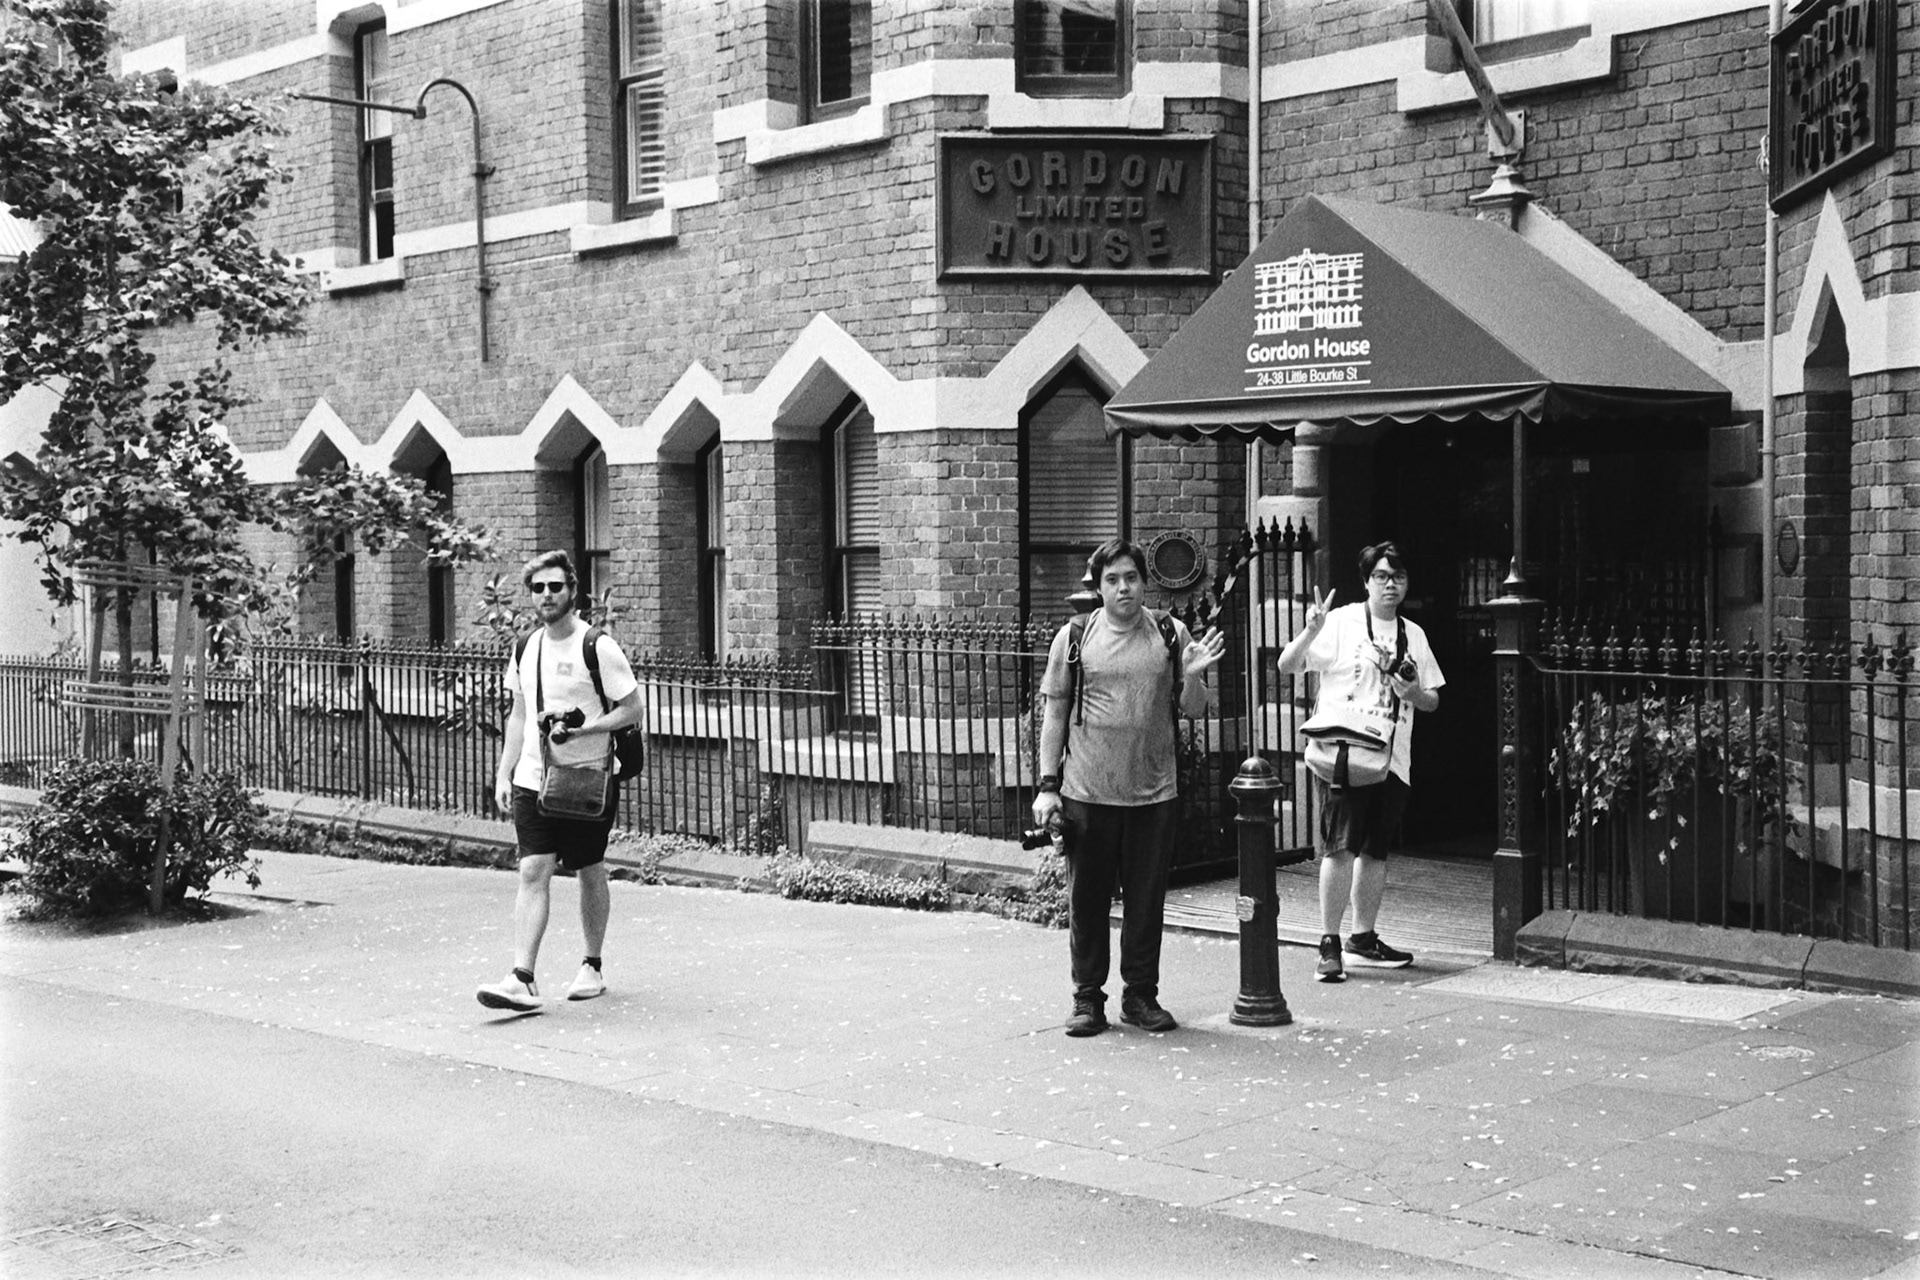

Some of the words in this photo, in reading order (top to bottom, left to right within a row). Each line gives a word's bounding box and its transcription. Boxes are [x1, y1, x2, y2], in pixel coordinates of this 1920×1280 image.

[1790, 79, 1869, 174] HOUSE
[969, 151, 1184, 194] GORDON
[1016, 196, 1144, 219] LIMITED
[985, 219, 1170, 263] HOUSE
[1246, 339, 1310, 363] Gordon
[1314, 337, 1371, 358] House
[1256, 371, 1284, 386] 24-38
[1285, 369, 1308, 384] Little
[1309, 367, 1344, 382] Bourke
[1346, 366, 1358, 380] St
